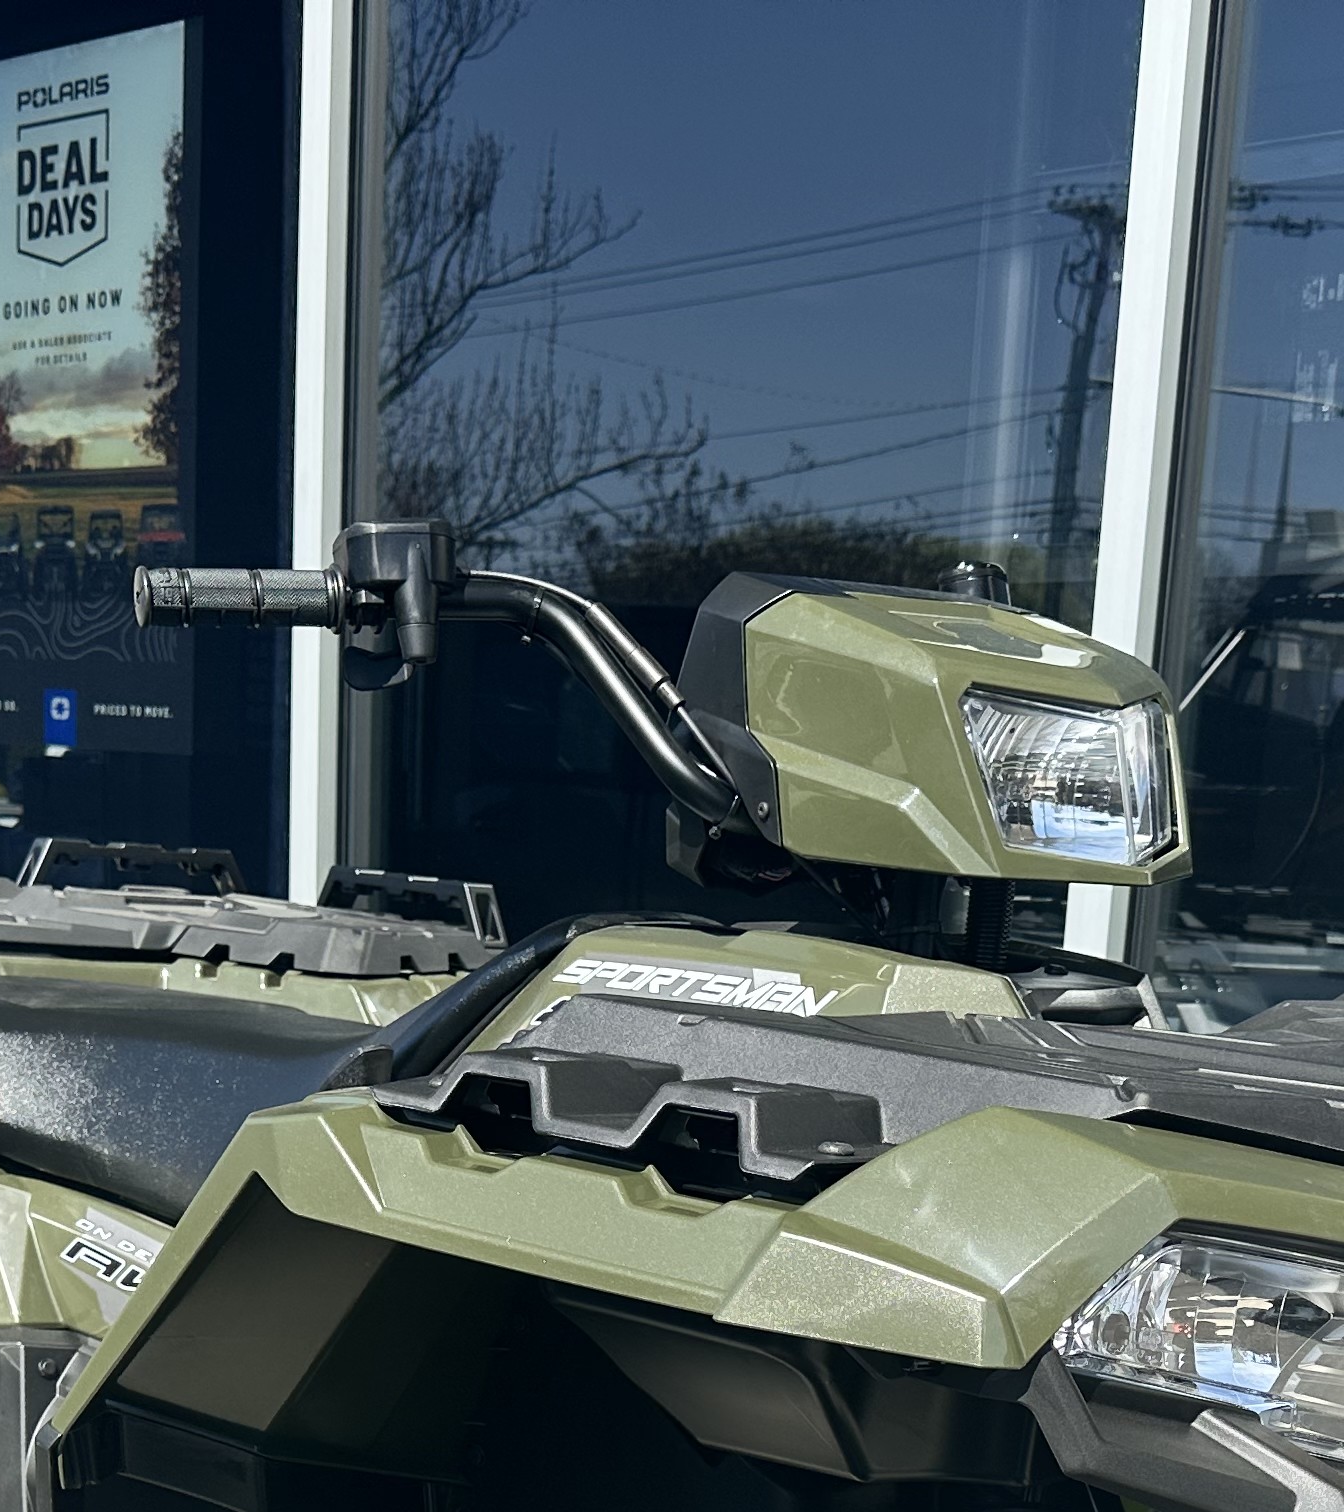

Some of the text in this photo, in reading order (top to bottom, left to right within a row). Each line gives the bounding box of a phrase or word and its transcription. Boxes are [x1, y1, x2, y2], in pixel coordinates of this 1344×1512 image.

[16, 73, 110, 112] POLARIS
[16, 136, 109, 197] DEAL
[27, 193, 97, 241] DAYS
[3, 288, 123, 320] GOING ON NOW
[93, 703, 127, 717] PRICED
[129, 705, 142, 718] TO
[552, 959, 840, 1018] SPORTSMAN
[75, 1218, 155, 1265] ON DE
